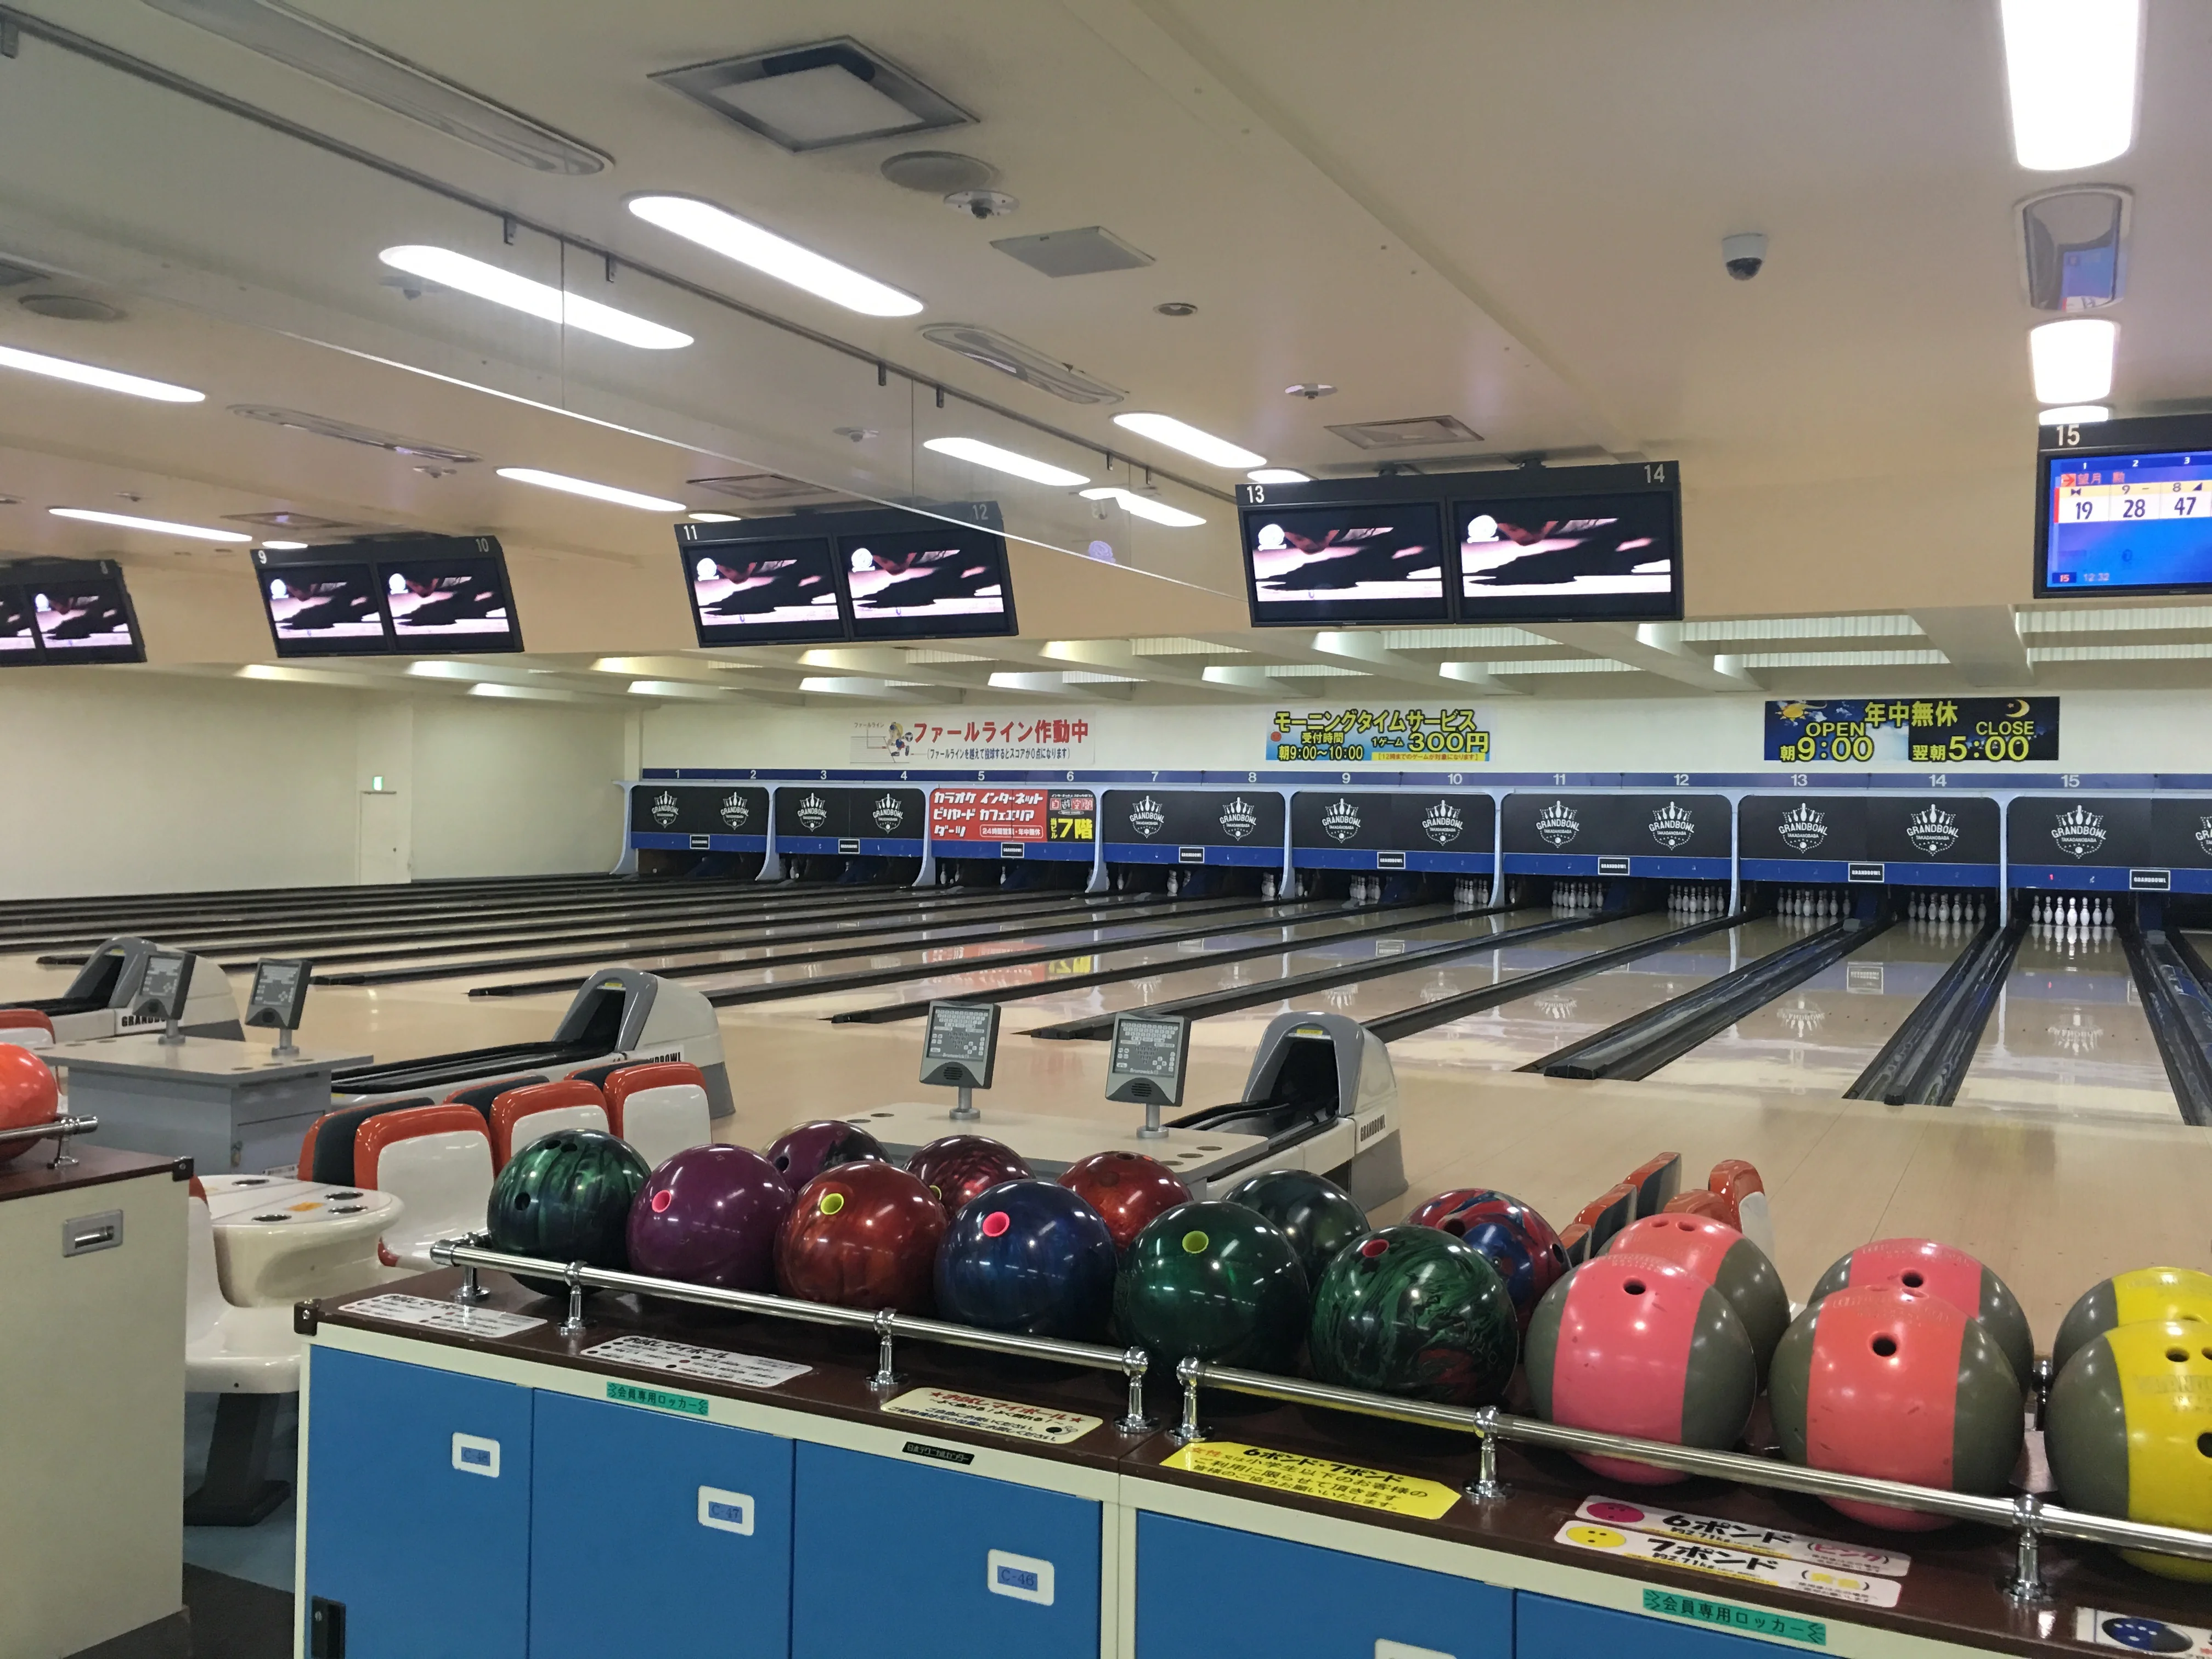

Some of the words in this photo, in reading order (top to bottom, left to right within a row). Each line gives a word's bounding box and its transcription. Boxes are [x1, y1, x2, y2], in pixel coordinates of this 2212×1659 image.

[2057, 424, 2080, 446] 15
[1644, 464, 1665, 484] 14
[2172, 482, 2181, 492] 8
[1246, 486, 1264, 503] 13
[972, 504, 988, 520] 12
[2076, 501, 2093, 520] 19
[2123, 499, 2146, 518] 28
[2174, 496, 2197, 516] 47
[683, 525, 698, 540] 11
[476, 538, 489, 552] 10
[258, 550, 267, 564] 9
[1865, 701, 1958, 727] 年中無休
[1274, 709, 1477, 733] モーニングタイムサービス
[914, 719, 1088, 743] ファールライン作動中
[1805, 723, 1865, 737] OPEN
[1976, 721, 2034, 736] CLOSE
[1301, 732, 1344, 744] 受付時間
[1372, 737, 1404, 748] 1ゲーム
[1408, 731, 1489, 753] 300円
[1780, 736, 1874, 762] 朝9:00
[675, 770, 680, 778] 1
[750, 770, 757, 779] 2
[820, 770, 827, 780] 3
[901, 771, 907, 780] 4
[978, 771, 985, 781] 5
[1067, 772, 1074, 781] 6
[1151, 772, 1159, 782] 7
[1248, 772, 1257, 782] 8
[1342, 773, 1351, 783] 9
[1448, 774, 1462, 785] 10
[1553, 774, 1566, 785] 11
[1674, 774, 1689, 786] 12
[1791, 775, 1808, 787] 13
[1928, 775, 1947, 787] 14
[2061, 775, 2080, 788] 15
[934, 792, 977, 804] カラオケ
[980, 792, 1043, 804] インターネット
[1052, 799, 1093, 809] 自遊空間
[873, 809, 903, 819] GRANDBOWL
[934, 806, 975, 820] ビリヤード
[980, 809, 1034, 821] カフェエリア
[1130, 812, 1164, 823] GRANDBOWL
[1220, 814, 1256, 825] GRANDBOWL
[1058, 818, 1093, 839] 7階
[1322, 816, 1361, 828] GRANDBOWL
[1422, 818, 1463, 830] GRANDBOWL
[1536, 819, 1579, 832] GRANDBOWL
[1649, 820, 1694, 834] GRANDBOWL
[934, 825, 966, 837] ダーツ
[1779, 824, 1828, 837] GRANDBOWL
[1906, 825, 1959, 838] GRANDBOWL
[2051, 826, 2107, 840] GRANDBOWL
[617, 1386, 697, 1409] 会員専用ロッカー
[1663, 1515, 1792, 1543] 6ポンド
[1647, 1538, 1779, 1570] 7ポンド
[1663, 1595, 1804, 1633] 会員専用ロッカー
